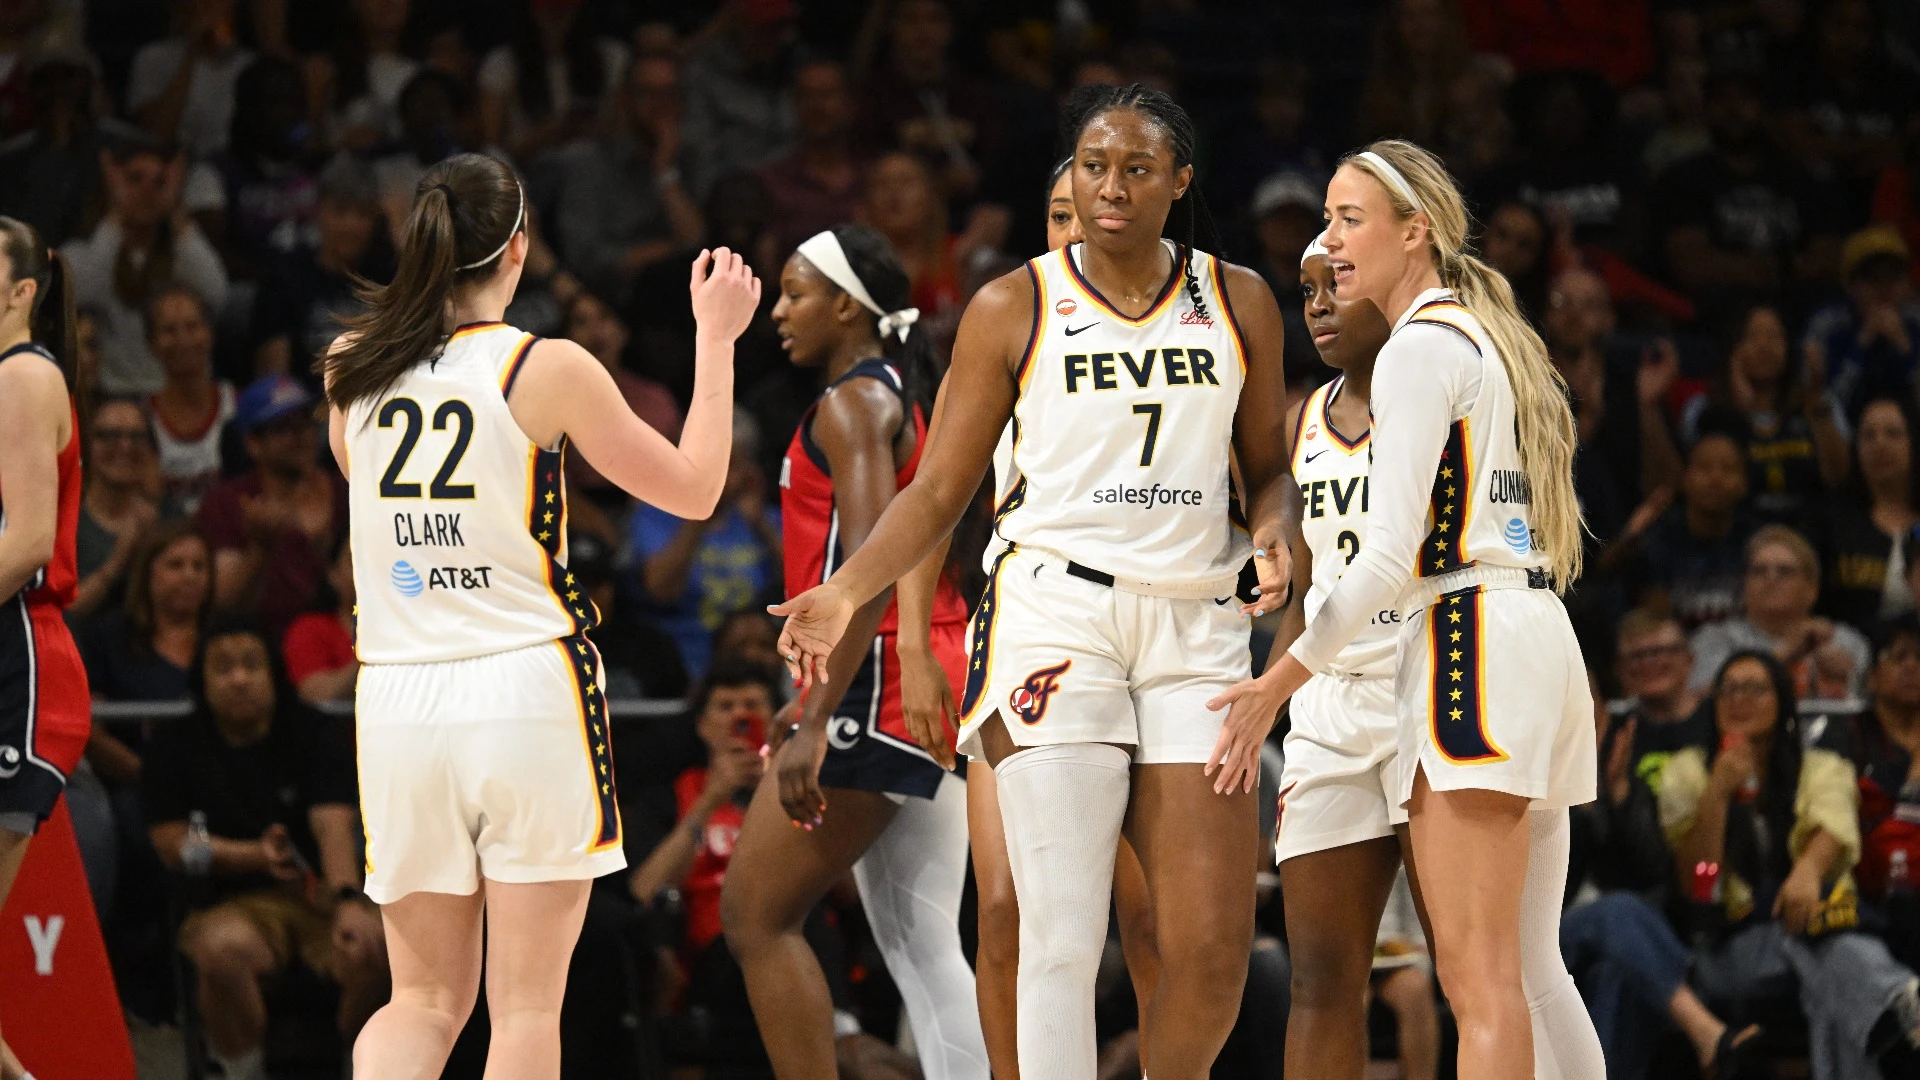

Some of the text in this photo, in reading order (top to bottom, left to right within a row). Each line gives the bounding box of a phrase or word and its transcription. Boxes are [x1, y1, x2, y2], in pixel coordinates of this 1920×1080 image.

[1064, 348, 1221, 394] FEVER
[378, 397, 476, 500] 22
[1131, 402, 1162, 468] 7
[1092, 483, 1203, 510] salesforce
[394, 513, 465, 547] CLARK
[429, 566, 492, 590] AT&T
[22, 914, 66, 977] Y
